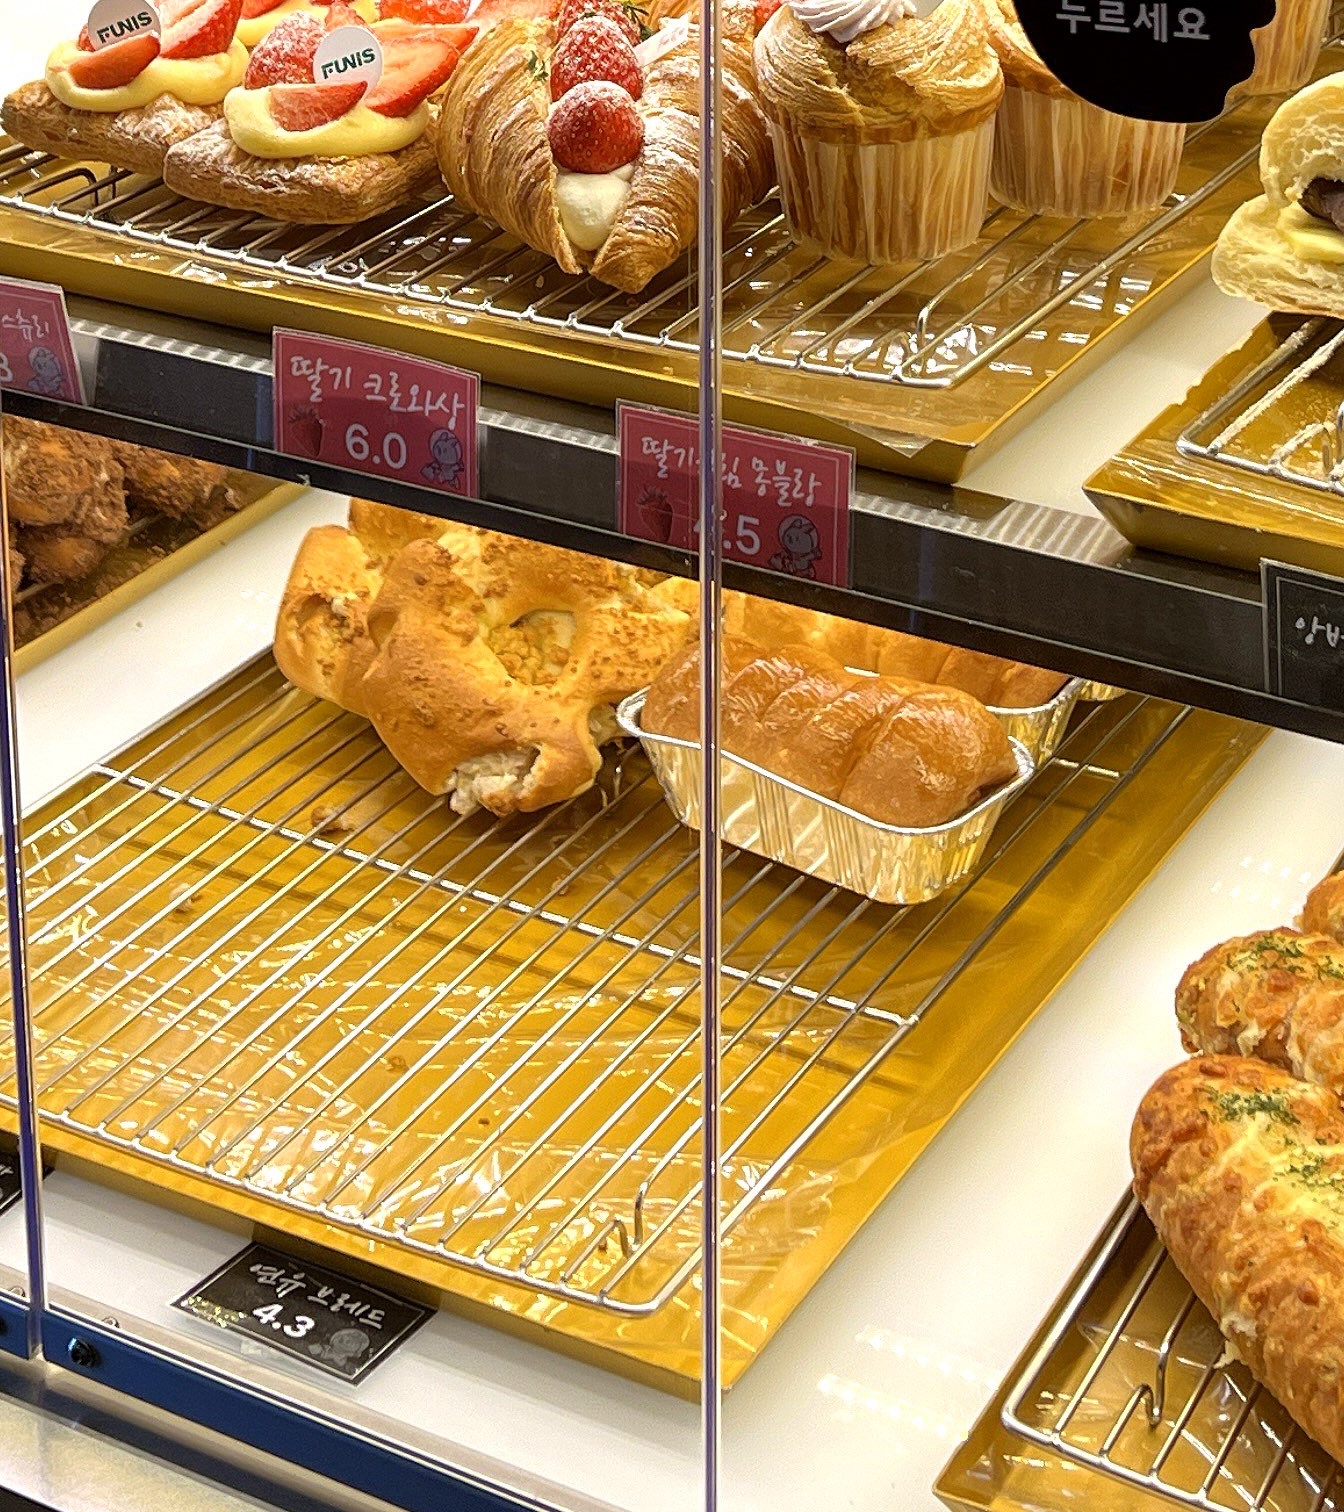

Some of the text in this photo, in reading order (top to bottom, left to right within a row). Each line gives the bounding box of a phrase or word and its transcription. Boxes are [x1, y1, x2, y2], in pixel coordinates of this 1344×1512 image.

[96, 10, 153, 44] FUNIS
[320, 46, 376, 80] FUNIS
[290, 355, 465, 431] 딸기 크로와상
[345, 423, 407, 470] 6.0
[751, 456, 823, 507] 몽블랑
[693, 513, 761, 556] .5
[249, 1262, 386, 1330] 연유 브레드
[252, 1302, 316, 1338] 4.3
